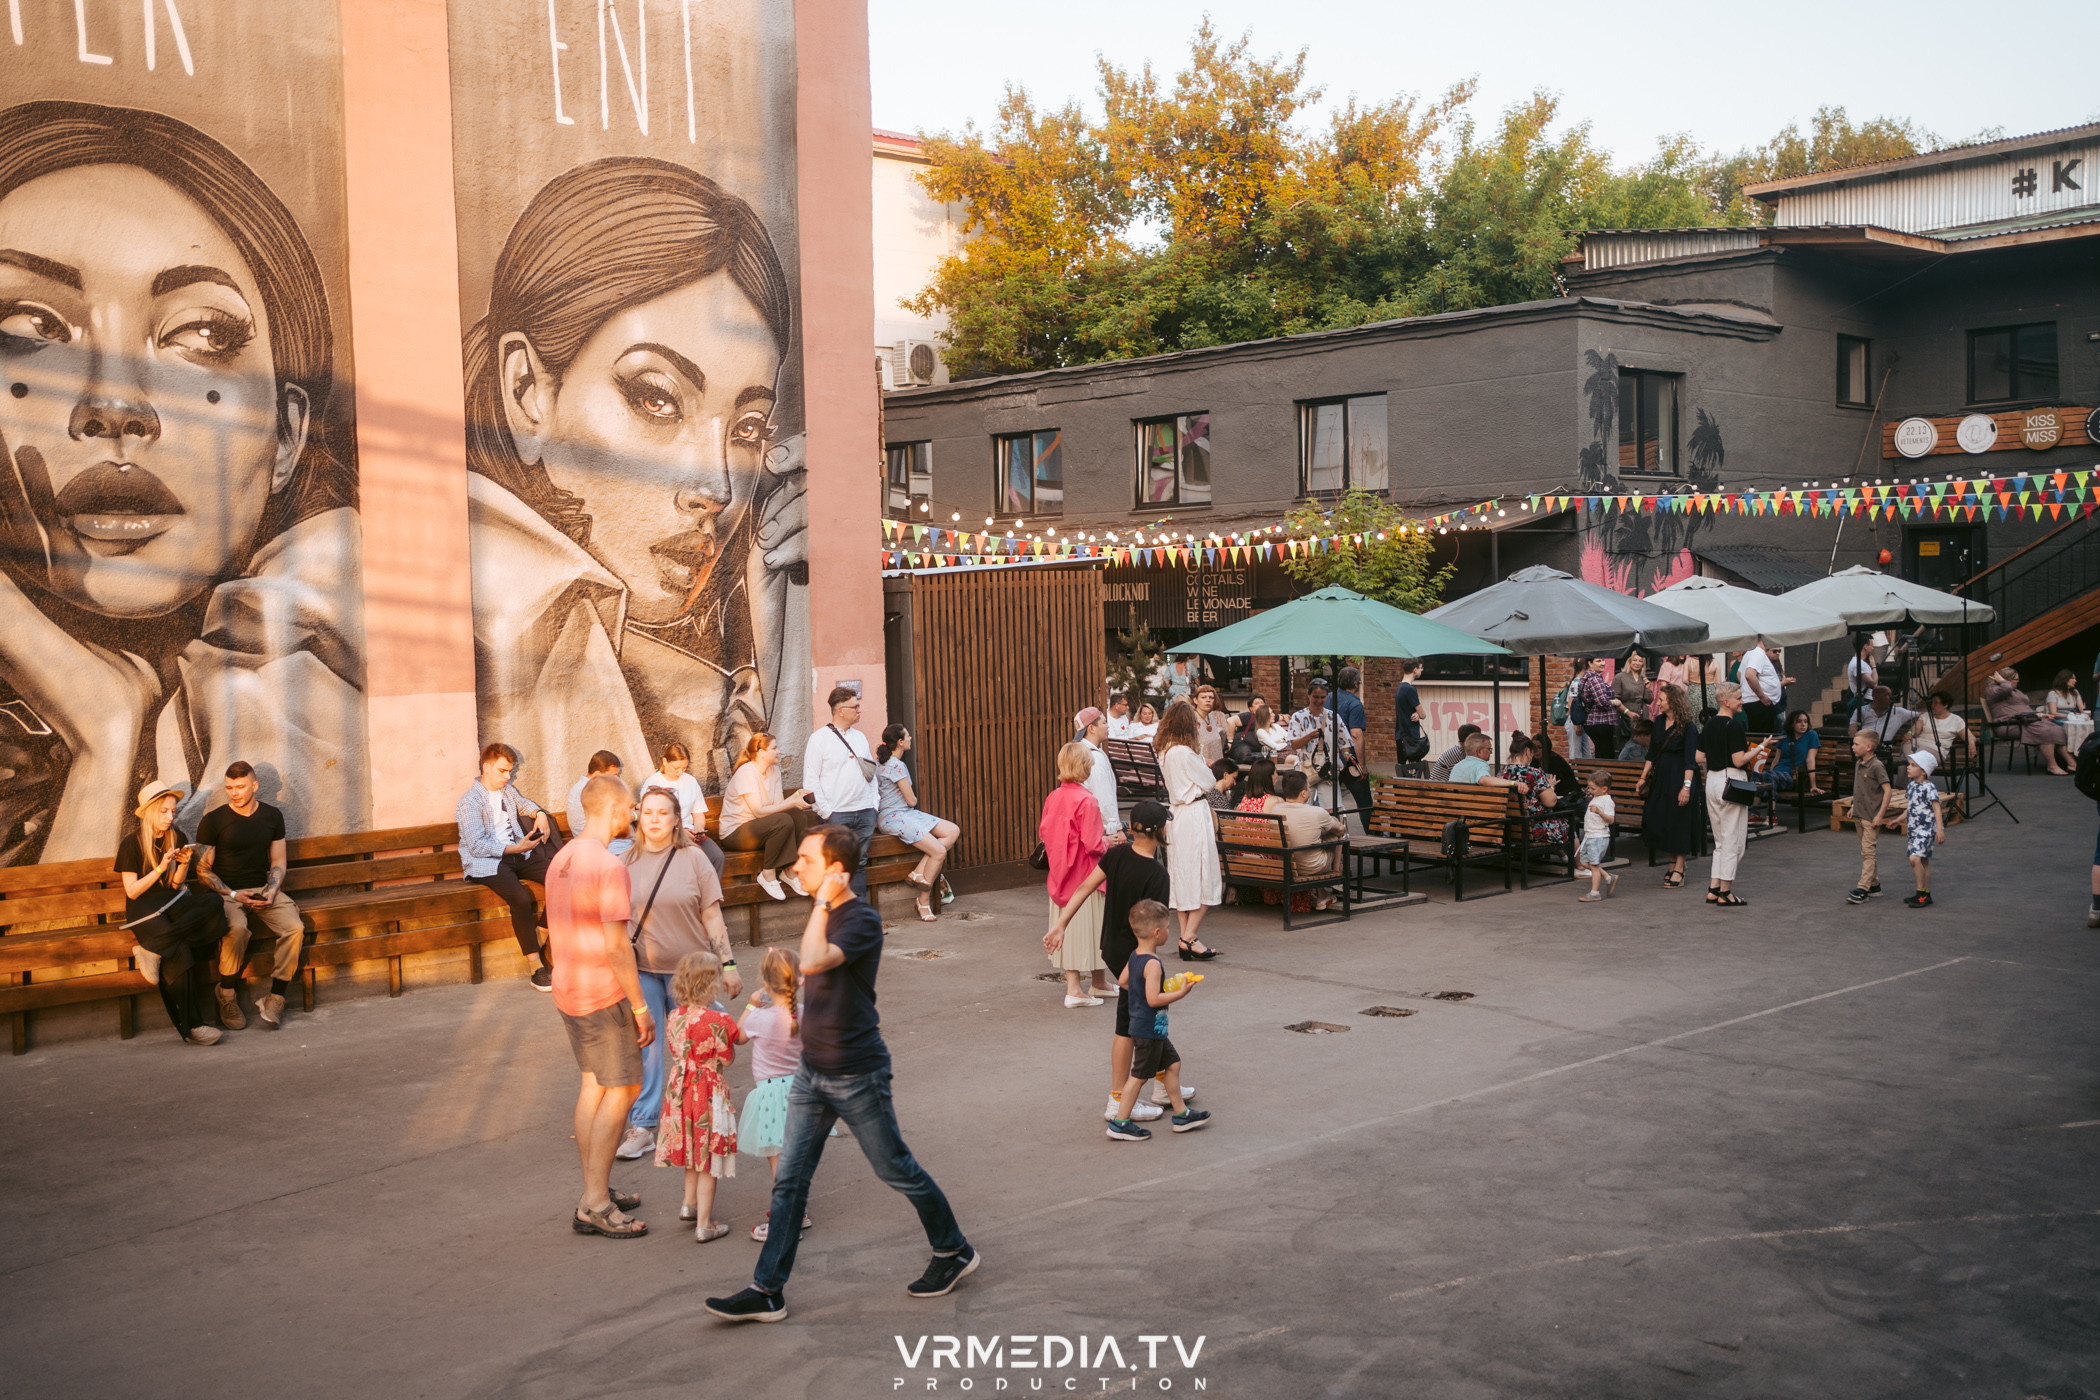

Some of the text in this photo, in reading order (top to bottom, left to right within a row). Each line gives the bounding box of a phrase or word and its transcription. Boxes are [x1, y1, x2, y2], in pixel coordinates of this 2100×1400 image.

[2026, 414, 2056, 428] KISS
[2026, 430, 2057, 443] MISS
[1103, 582, 1150, 602] BLOCKNOT
[1186, 585, 1218, 598] WNE
[1186, 597, 1252, 610] LEMONADE
[1187, 611, 1218, 623] BEER
[1430, 701, 1519, 732] ITEA
